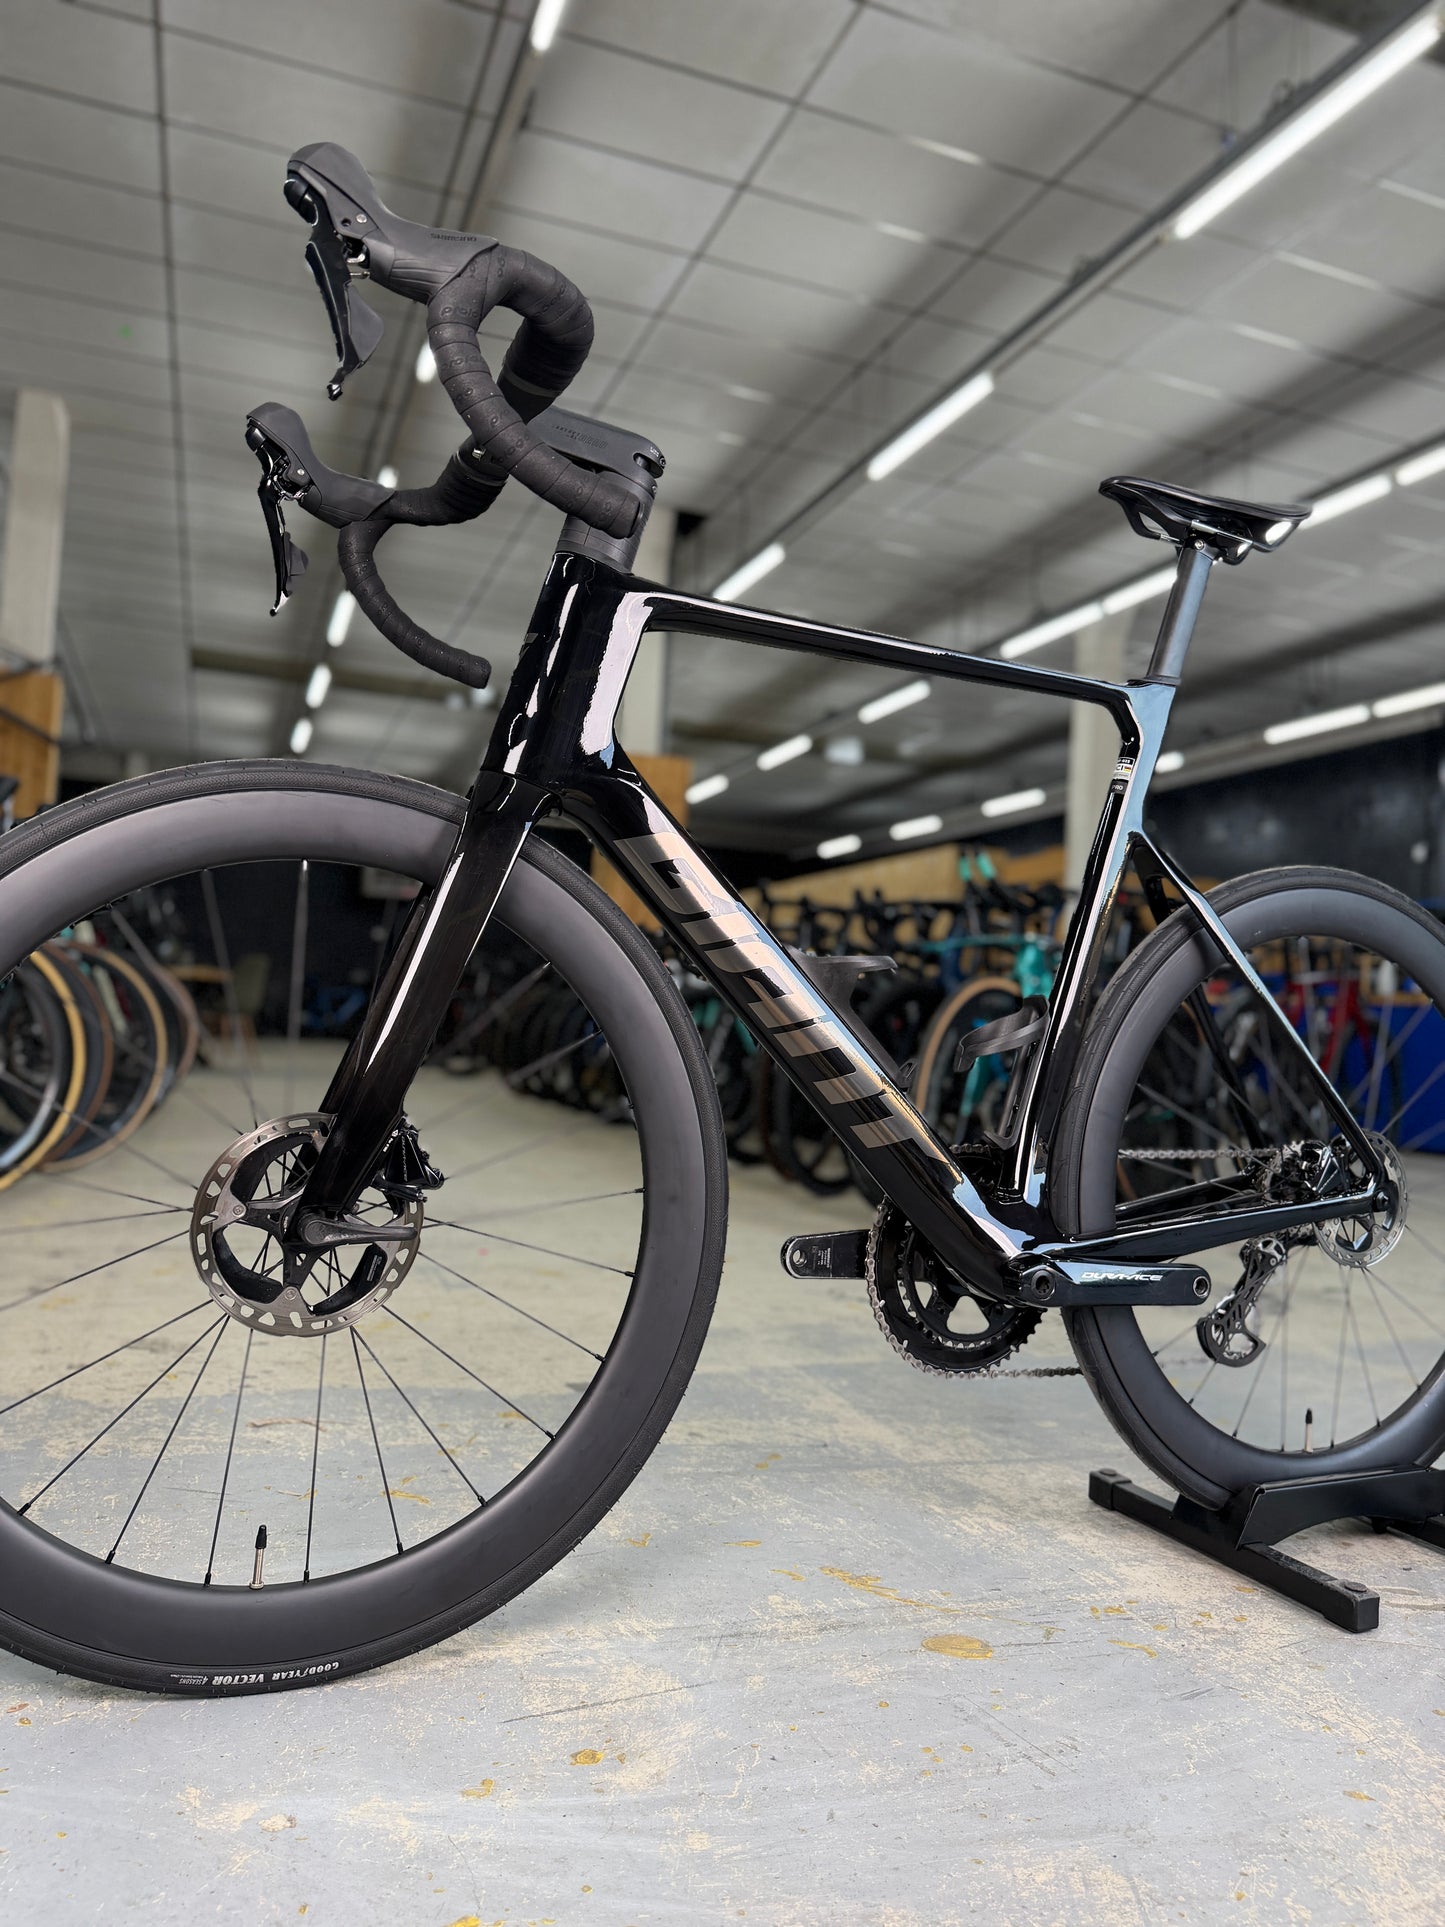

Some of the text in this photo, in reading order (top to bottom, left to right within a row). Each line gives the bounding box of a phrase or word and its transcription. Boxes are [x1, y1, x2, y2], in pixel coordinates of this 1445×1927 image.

[613, 831, 949, 1163] GIANT
[1081, 1271, 1164, 1282] DURA-ACE
[212, 1661, 340, 1686] GOODYEAR VECTOR
